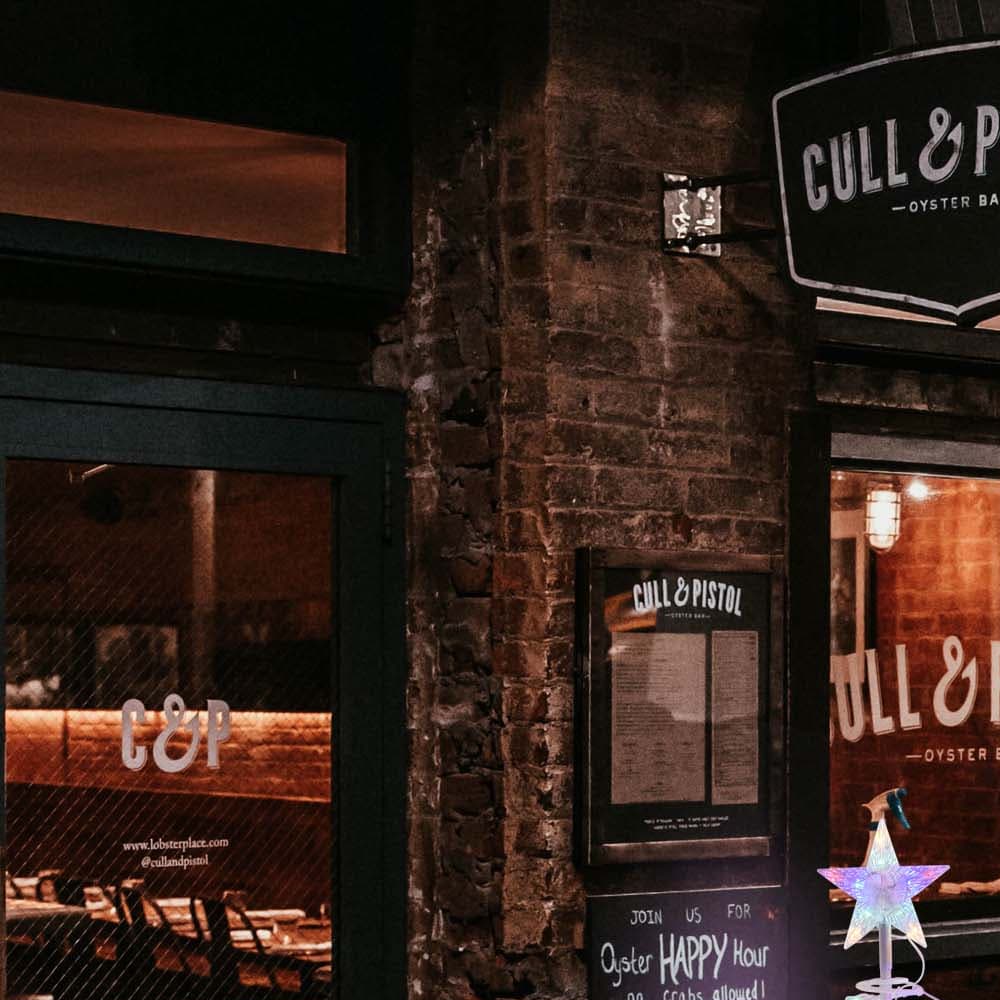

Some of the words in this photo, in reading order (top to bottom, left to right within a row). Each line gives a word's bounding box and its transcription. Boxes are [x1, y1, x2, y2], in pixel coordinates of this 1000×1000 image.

[803, 117, 908, 212] CULL
[918, 106, 965, 184] &
[909, 196, 972, 213] OYSTER
[632, 578, 672, 613] CULL
[673, 576, 690, 608] &
[692, 578, 742, 617] PISTOL
[830, 643, 923, 745] ULL
[933, 635, 979, 728] &
[925, 748, 987, 763] OYSTER
[123, 836, 229, 852] www.lobsterplace.com
[141, 854, 209, 870] @cullandpistol
[630, 909, 663, 926] JOIN
[685, 906, 703, 924] US
[727, 903, 752, 919] FOR
[601, 941, 654, 988] Oyster
[659, 932, 728, 985] HAPPY
[733, 938, 770, 968] Hour
